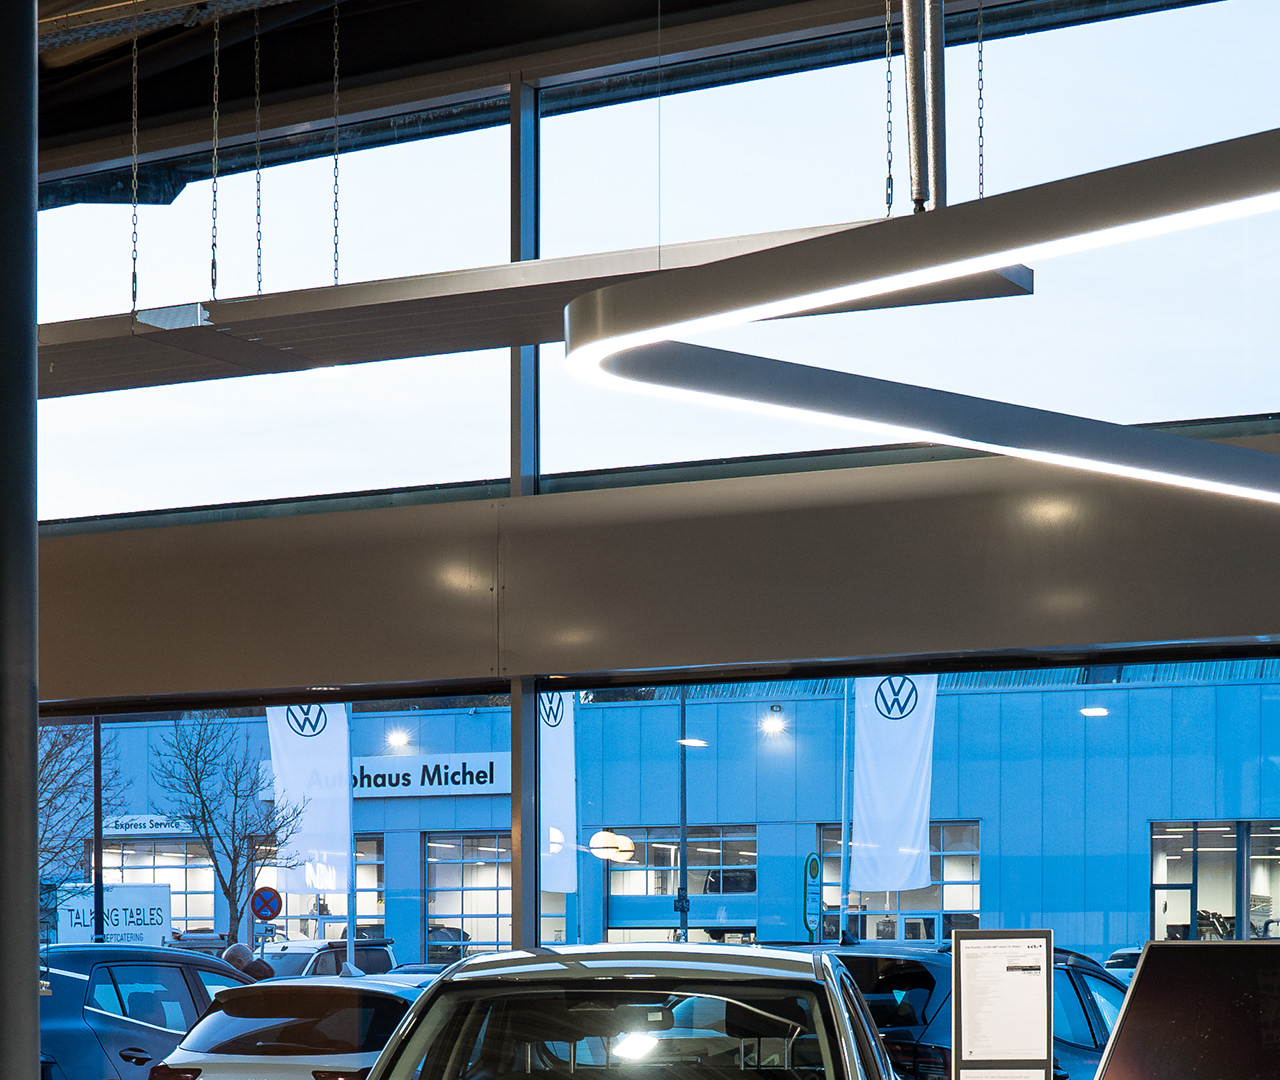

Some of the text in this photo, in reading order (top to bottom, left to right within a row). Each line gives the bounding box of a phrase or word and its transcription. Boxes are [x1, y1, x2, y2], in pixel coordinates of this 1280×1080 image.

[420, 761, 495, 787] Michel
[114, 820, 180, 831] Express Service
[68, 907, 163, 928] TALKNG TABLES
